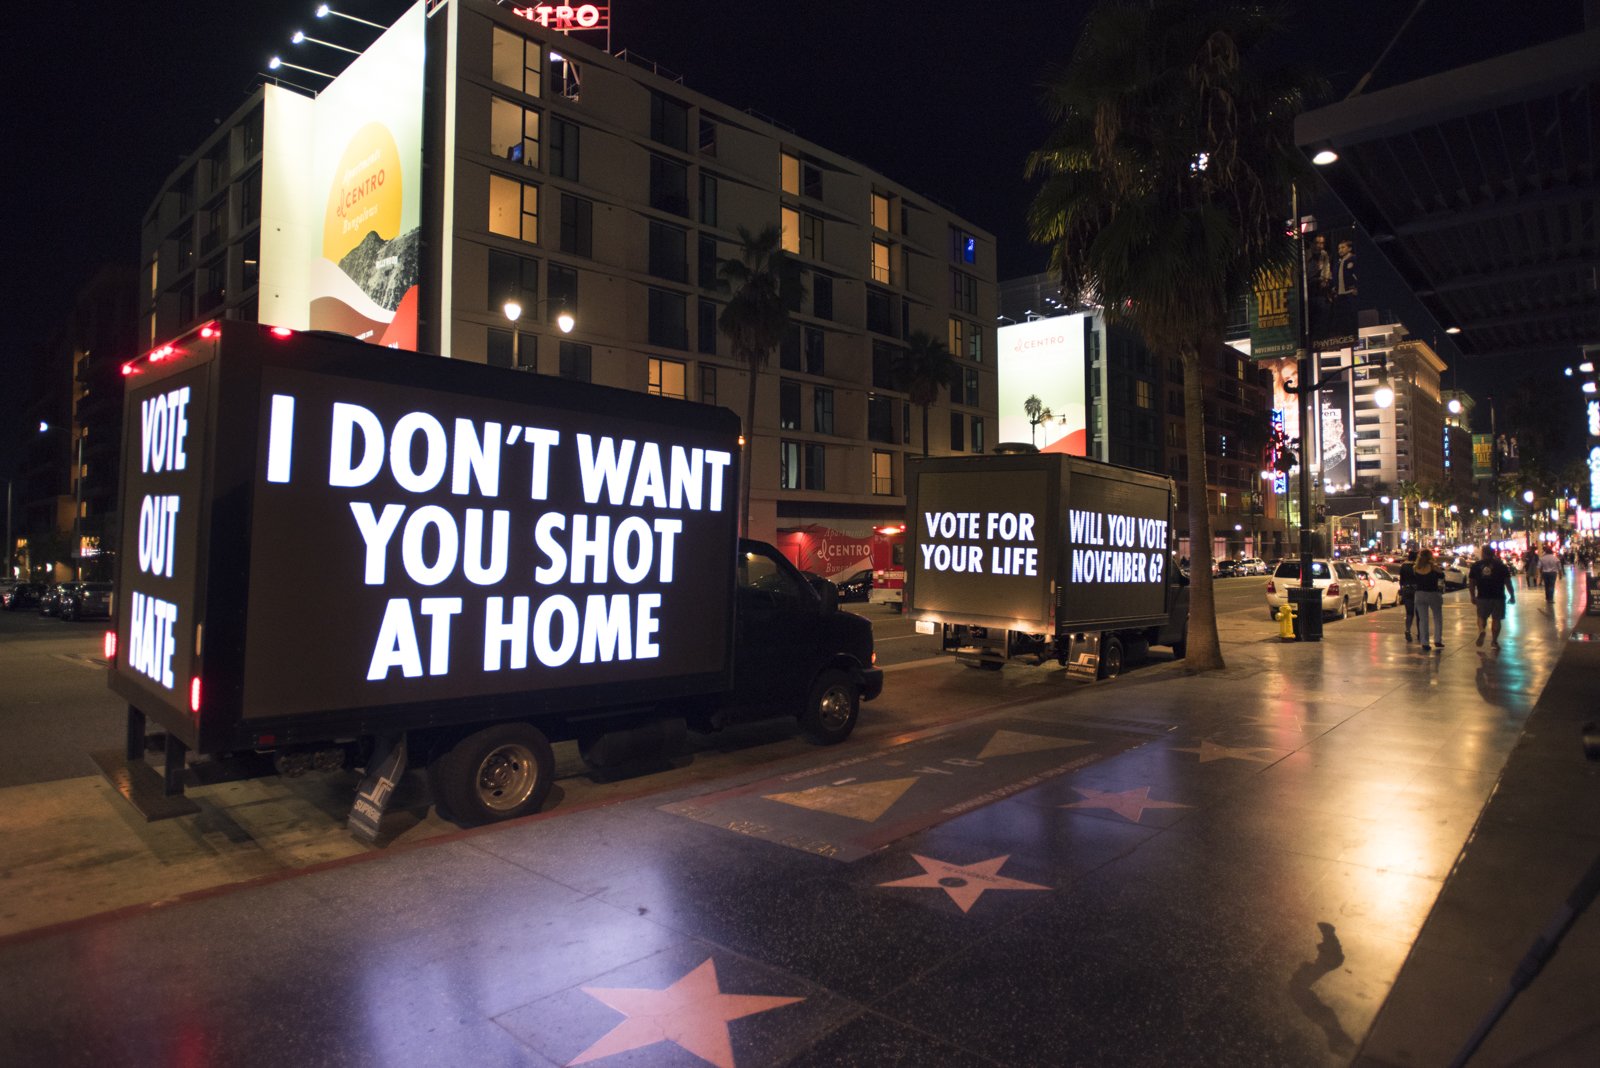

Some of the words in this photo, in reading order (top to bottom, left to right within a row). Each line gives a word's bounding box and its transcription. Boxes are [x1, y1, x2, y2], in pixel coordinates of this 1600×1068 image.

[1256, 288, 1288, 317] TALE
[1254, 345, 1281, 354] NOVEMBER
[1312, 335, 1356, 349] PANTAGES
[142, 387, 190, 473] VOTE
[267, 395, 295, 483] I
[328, 402, 560, 501] DON'T
[576, 433, 731, 512] WANT
[138, 495, 180, 578] OUT
[350, 501, 510, 586] YOU
[534, 511, 683, 585] SHOT
[924, 511, 981, 539] VOTE
[987, 512, 1035, 541] FOR
[1069, 509, 1104, 545] WILL
[1107, 513, 1136, 548] YOU
[1138, 517, 1168, 550] VOTE
[920, 544, 984, 573] YOUR
[991, 546, 1038, 577] LIFE
[1071, 549, 1146, 583] NOVEMBER
[1149, 553, 1164, 583] 6?
[129, 591, 178, 688] HATE
[366, 598, 463, 681] AT
[483, 593, 662, 672] HOME
